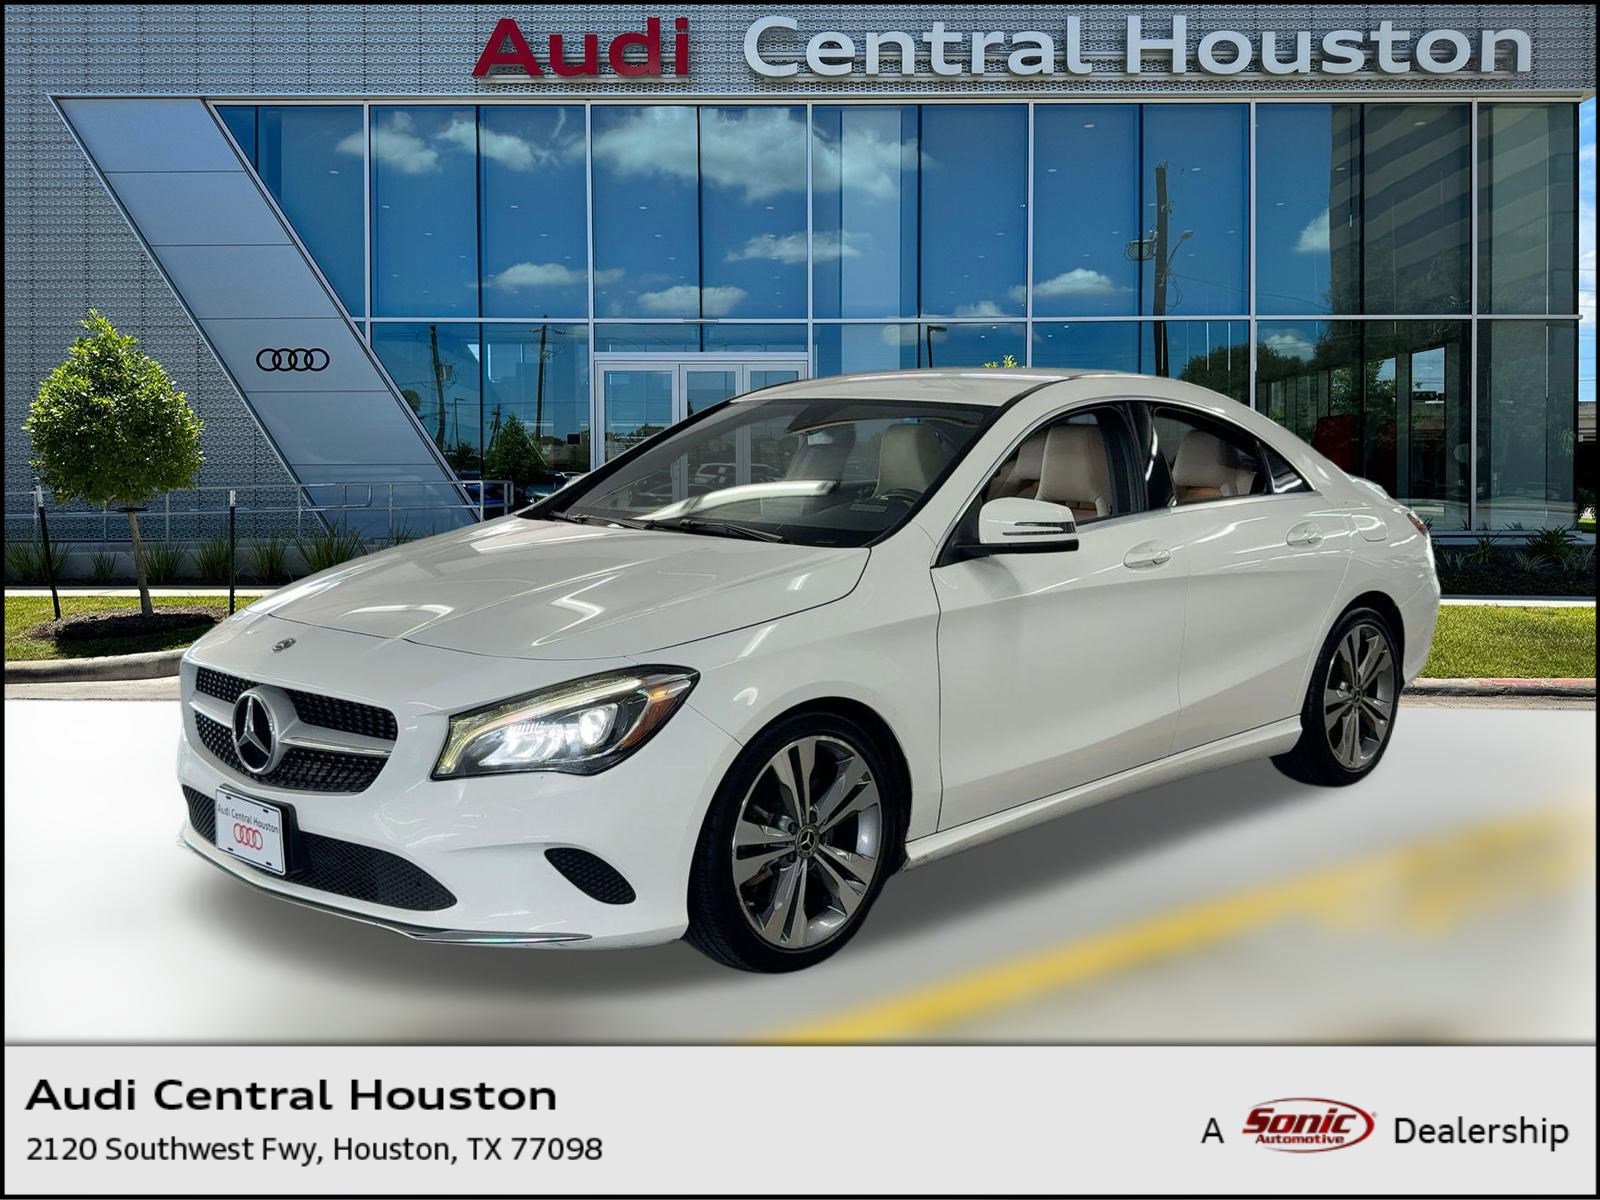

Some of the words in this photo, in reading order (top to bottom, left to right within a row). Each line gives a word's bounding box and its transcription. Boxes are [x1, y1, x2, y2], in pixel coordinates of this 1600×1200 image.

[473, 15, 690, 77] Audi
[742, 14, 1093, 77] Central
[1126, 14, 1532, 76] Houston
[218, 804, 230, 816] Audi
[231, 809, 252, 825] Central
[253, 816, 279, 833] Houston
